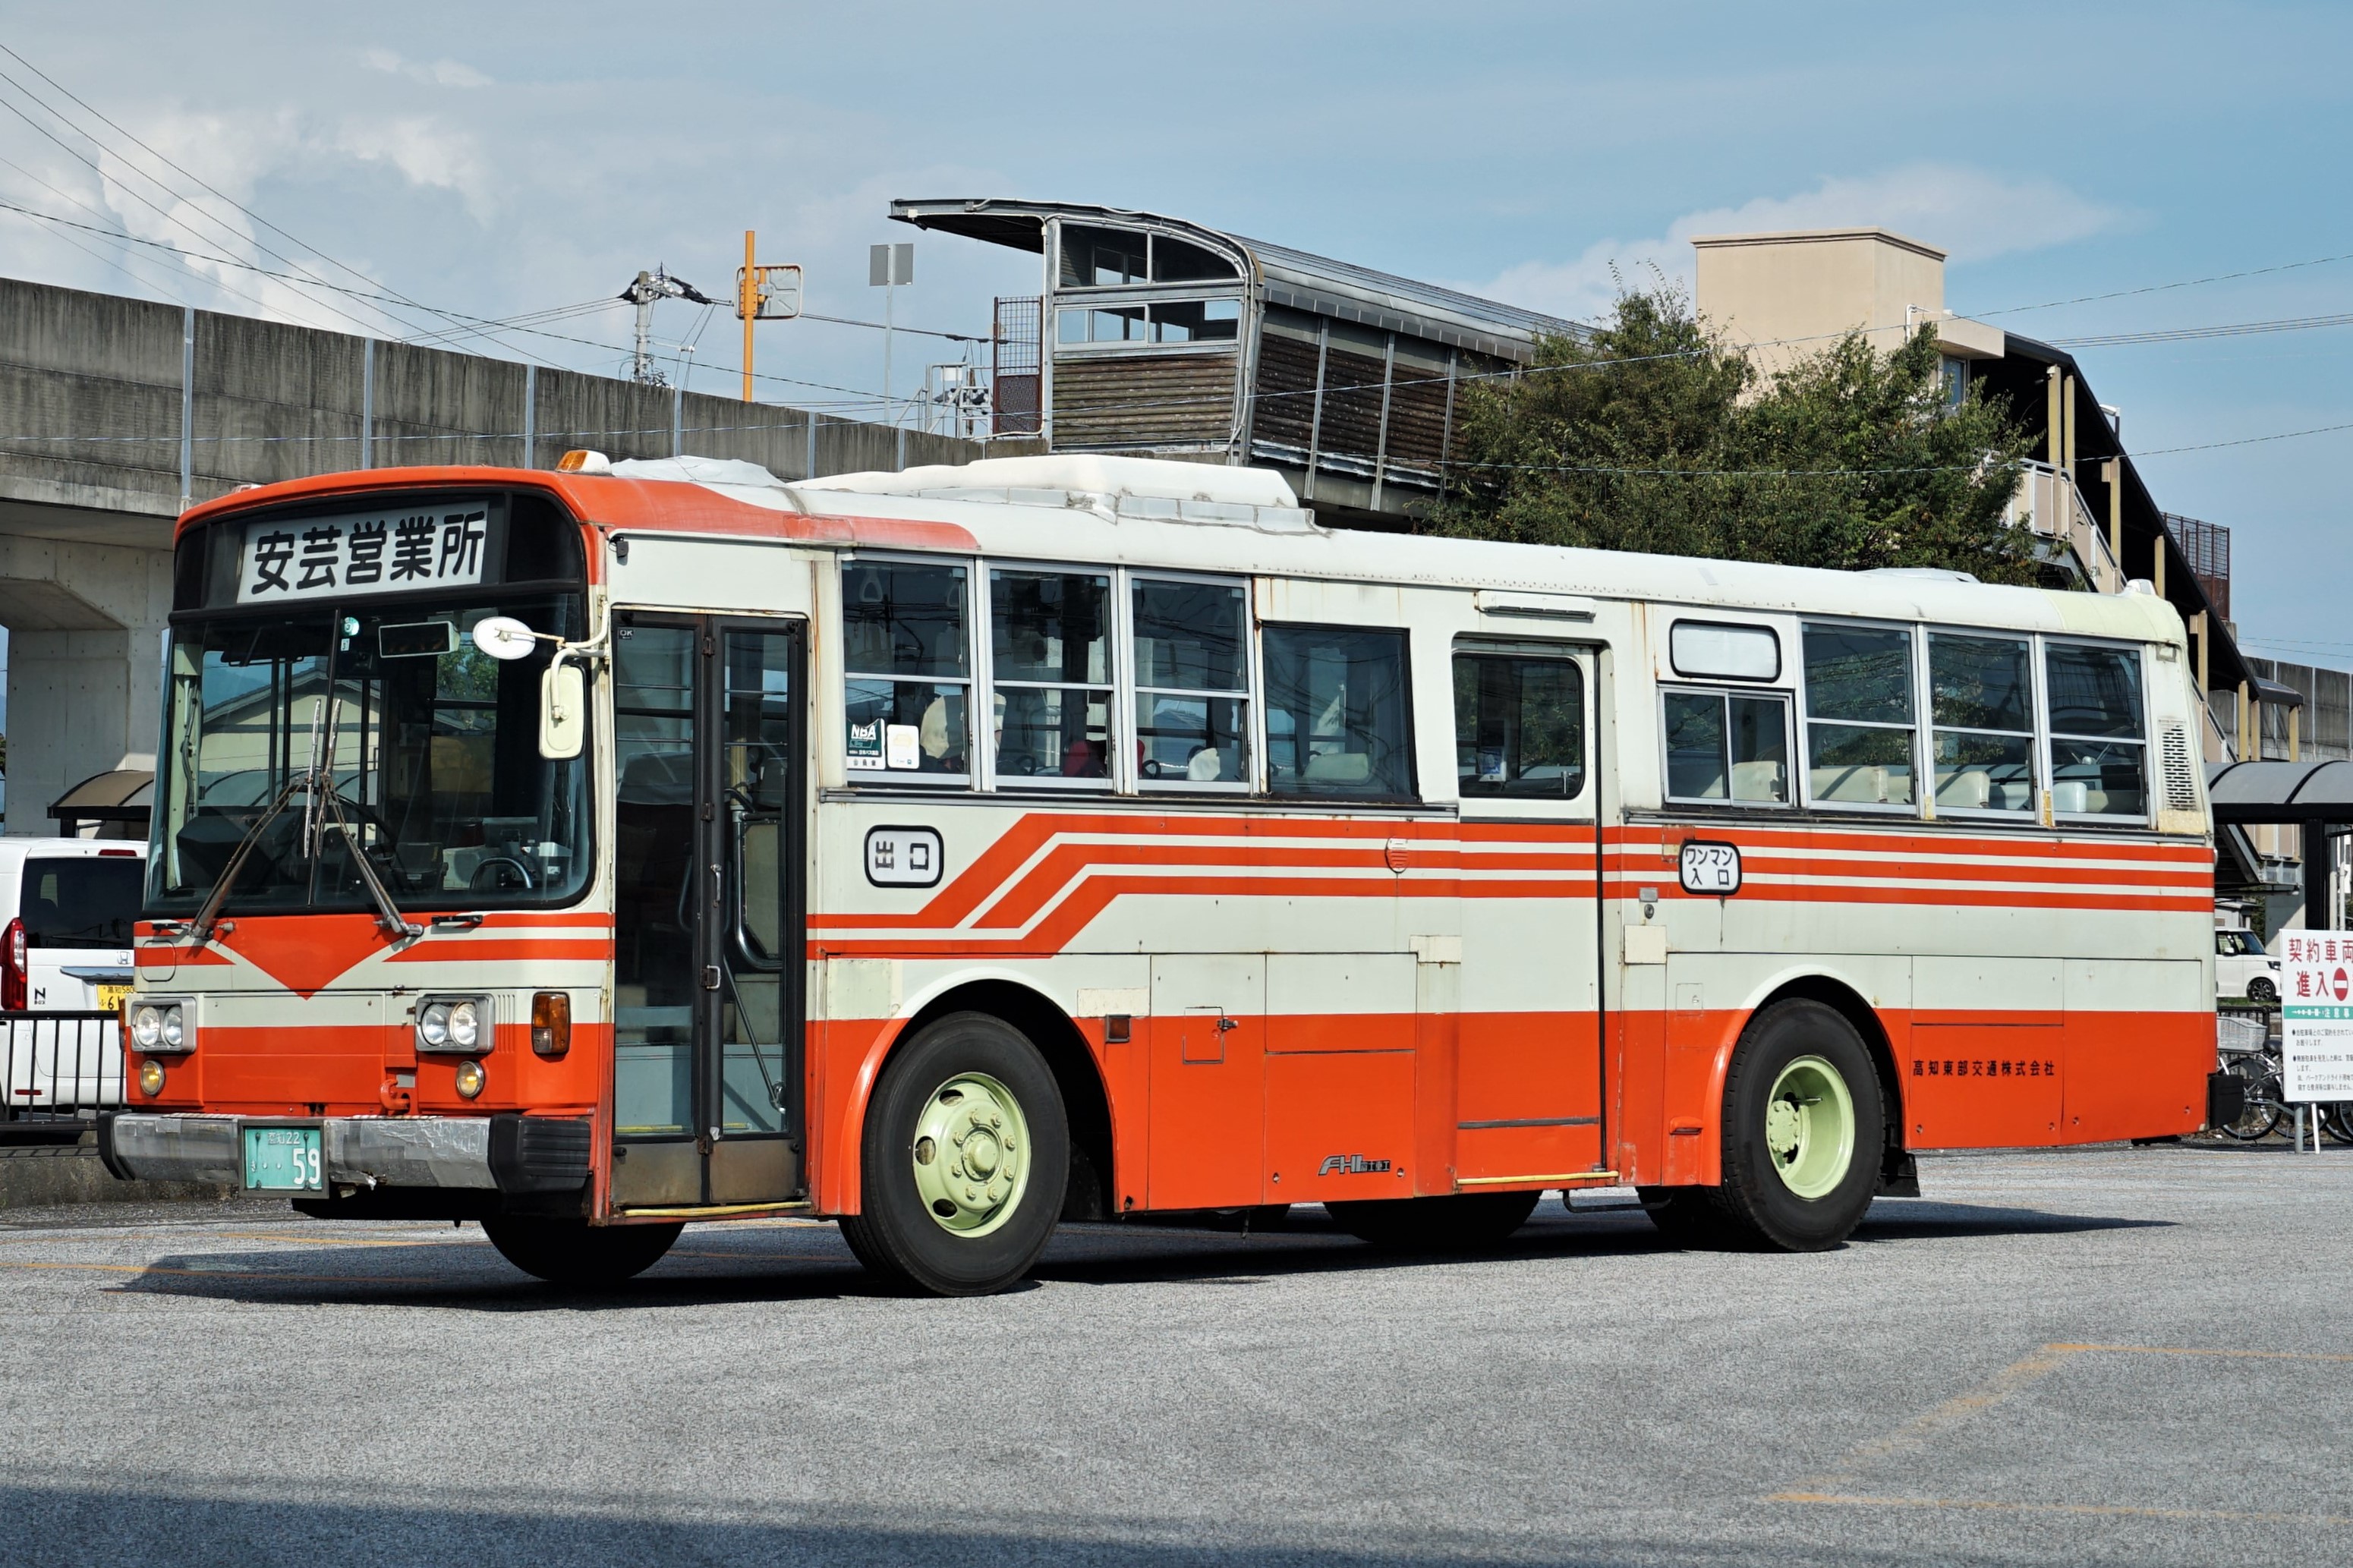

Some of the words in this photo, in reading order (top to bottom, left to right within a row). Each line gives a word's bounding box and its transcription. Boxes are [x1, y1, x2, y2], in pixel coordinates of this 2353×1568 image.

[251, 510, 486, 595] 安芸営業所
[875, 840, 929, 871] 出口
[1686, 848, 1733, 866] ワンマン
[1691, 867, 1730, 886] 入口
[2288, 937, 2353, 964] 契約車両
[34, 987, 46, 1000] N
[1913, 1060, 2055, 1077] 高知東部交通株式会社
[292, 1148, 320, 1185] 59
